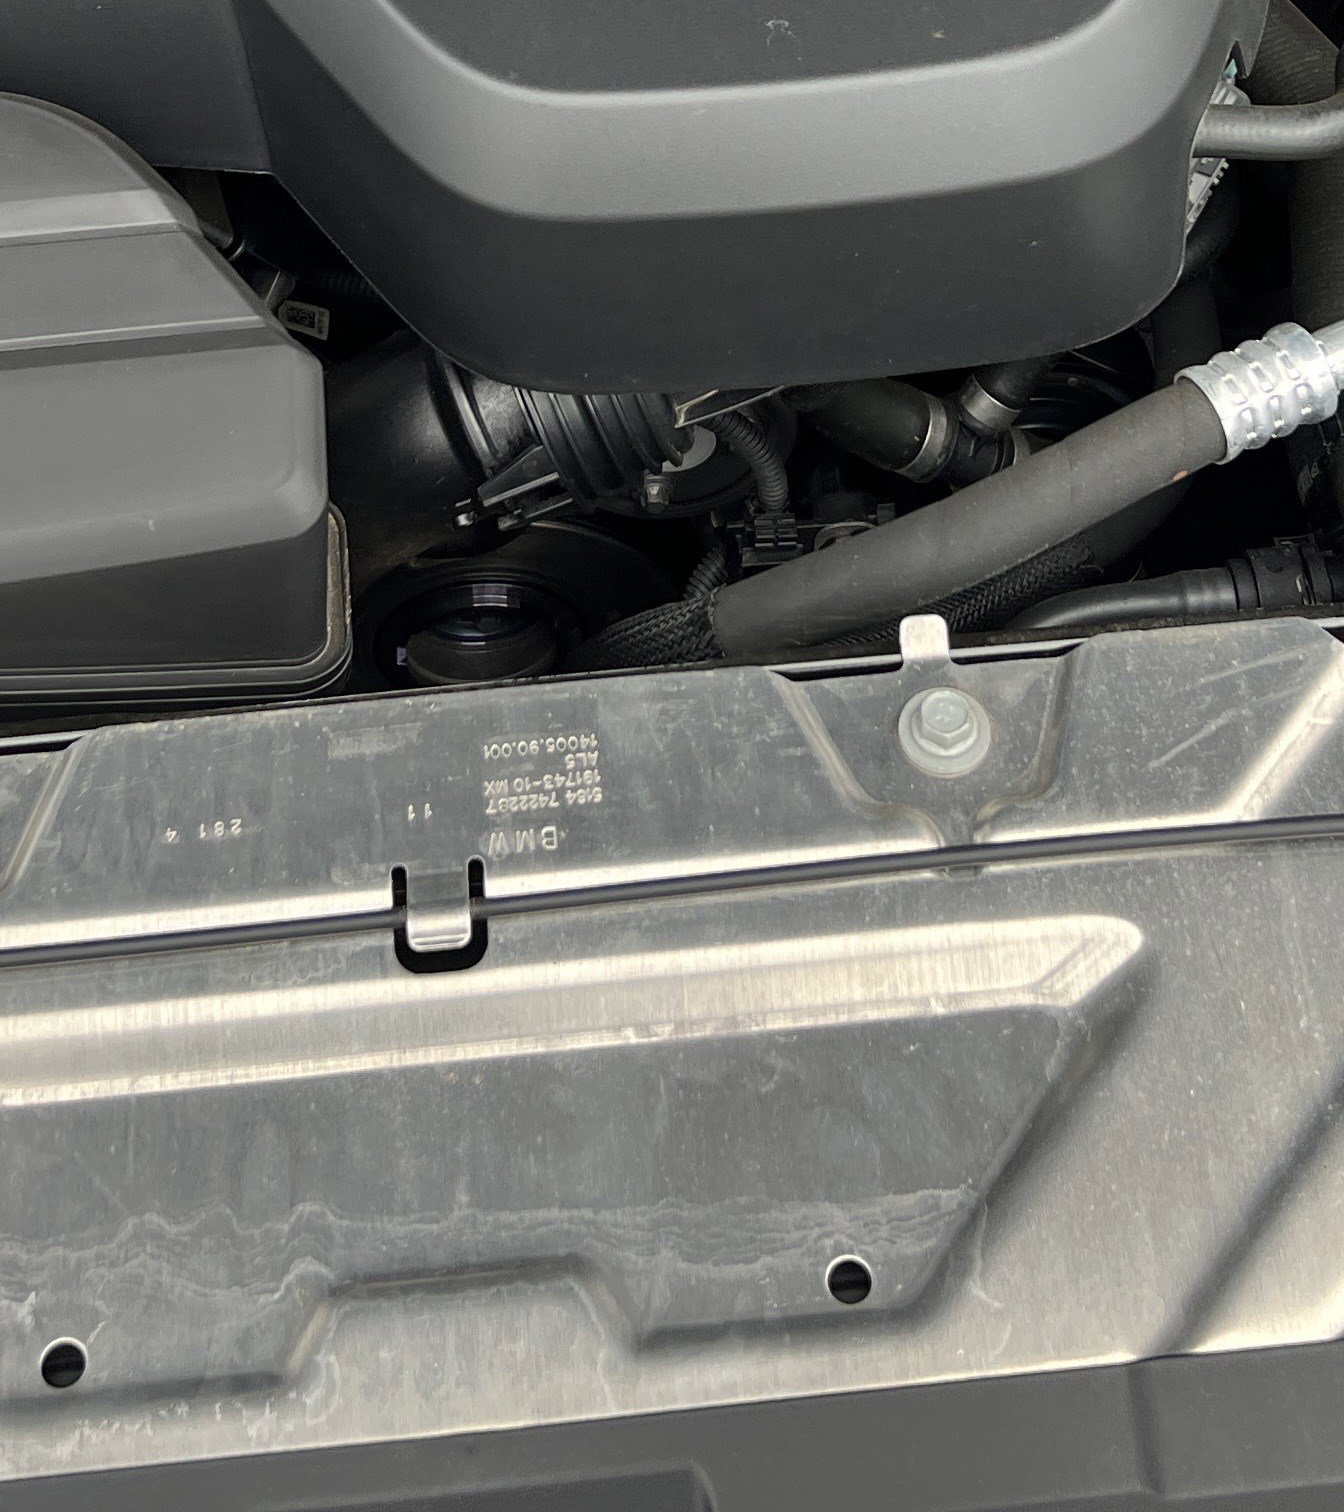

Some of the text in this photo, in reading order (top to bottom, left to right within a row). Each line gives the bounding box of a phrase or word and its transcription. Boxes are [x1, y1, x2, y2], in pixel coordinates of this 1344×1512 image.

[483, 733, 598, 759] 14005.90.001
[484, 769, 601, 796] 191743-10 MX
[485, 786, 603, 815] 5164 7422287
[488, 826, 558, 857] BMW
